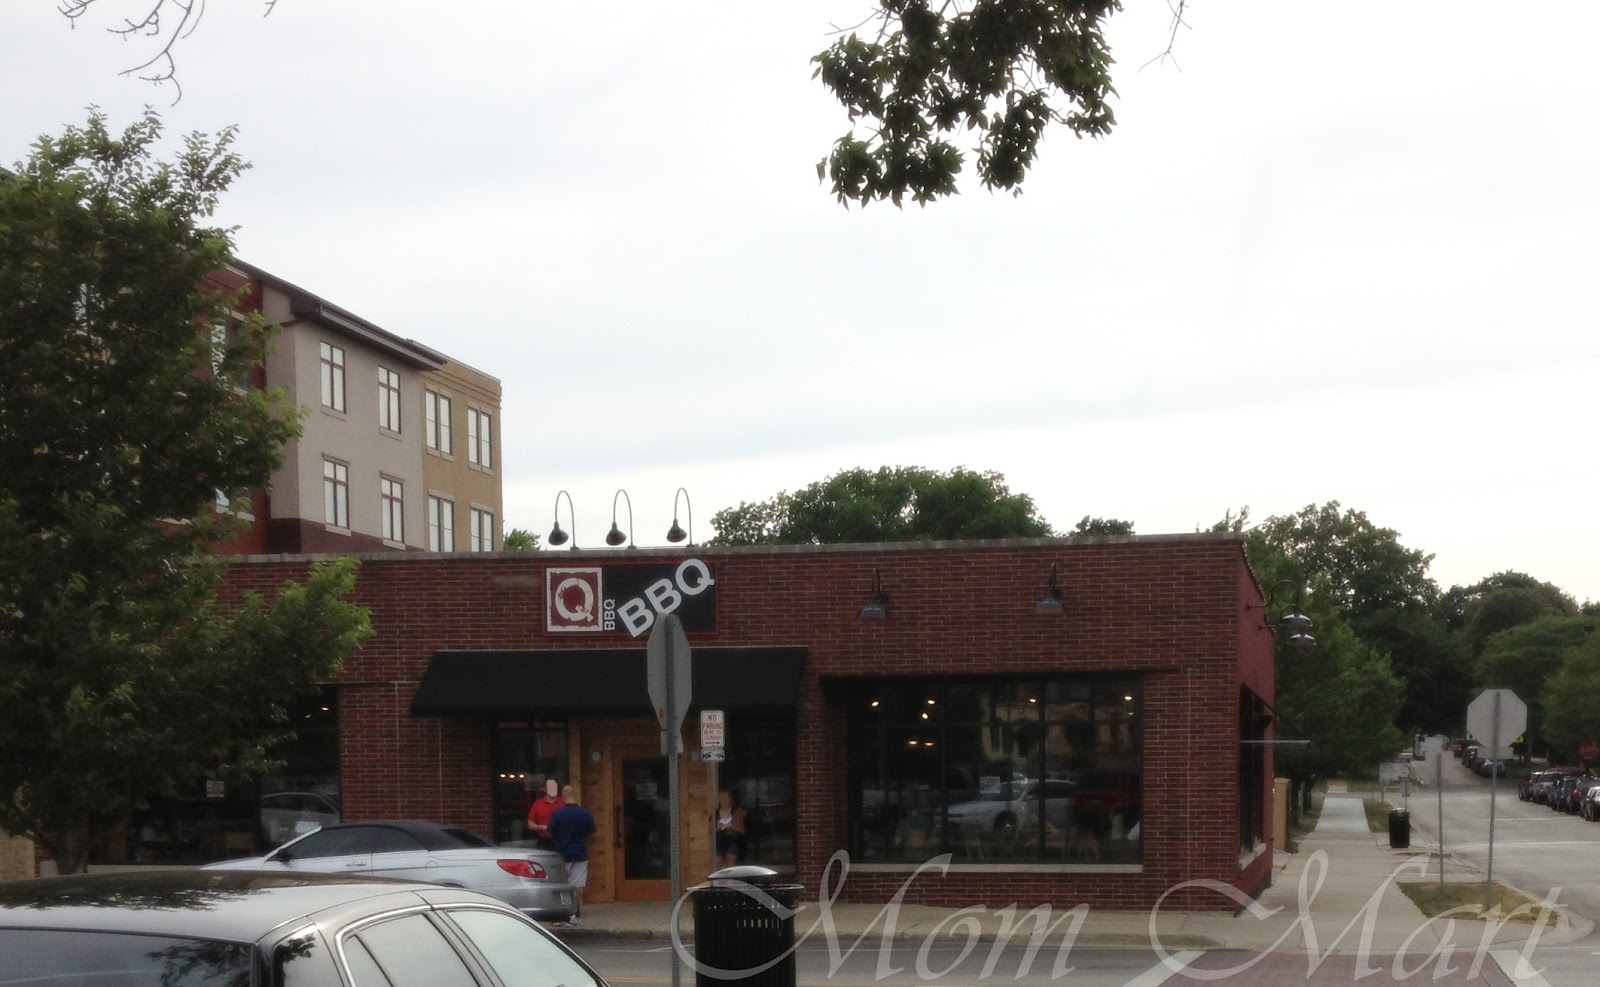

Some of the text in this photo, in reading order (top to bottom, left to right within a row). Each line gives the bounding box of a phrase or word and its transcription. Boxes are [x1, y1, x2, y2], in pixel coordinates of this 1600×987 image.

[555, 577, 594, 622] Q
[604, 599, 616, 631] BBQ
[617, 558, 715, 638] BBQ
